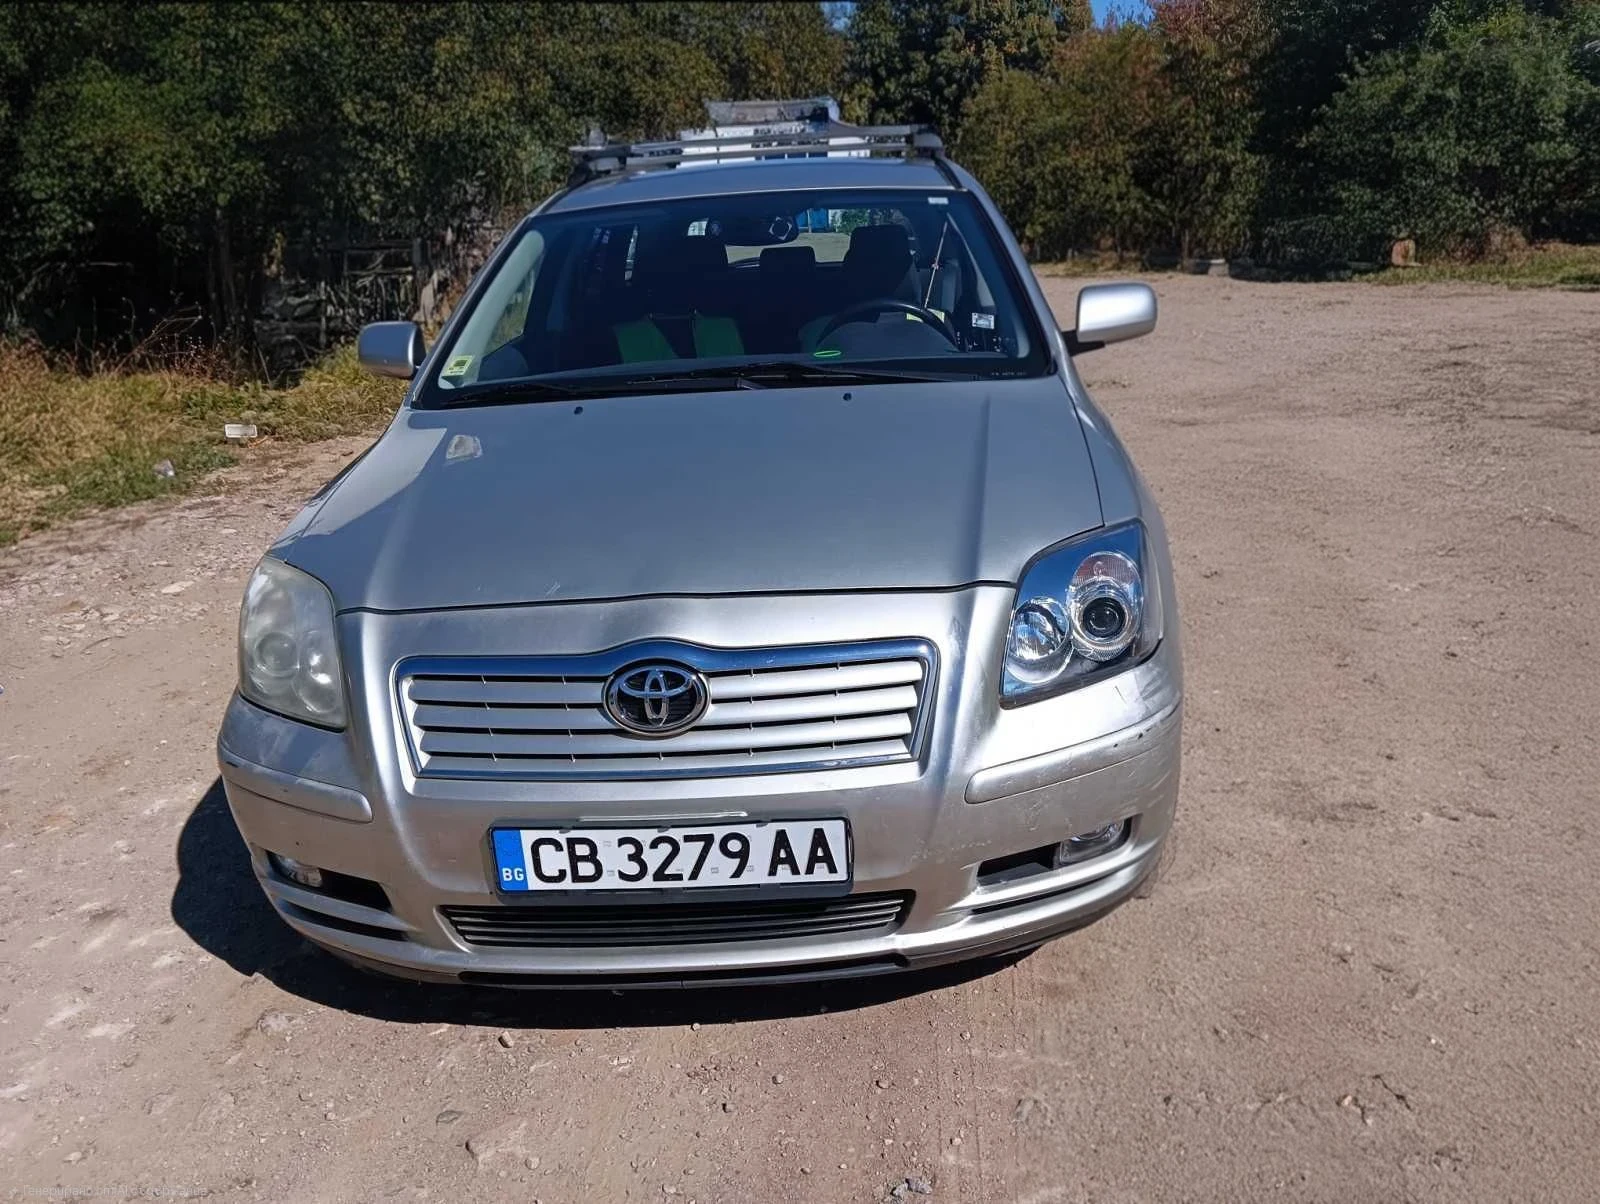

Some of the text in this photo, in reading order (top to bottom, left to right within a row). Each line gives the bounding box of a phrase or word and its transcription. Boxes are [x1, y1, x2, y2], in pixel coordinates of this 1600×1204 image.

[530, 827, 838, 884] CB 3279 AA
[502, 867, 525, 882] BG
